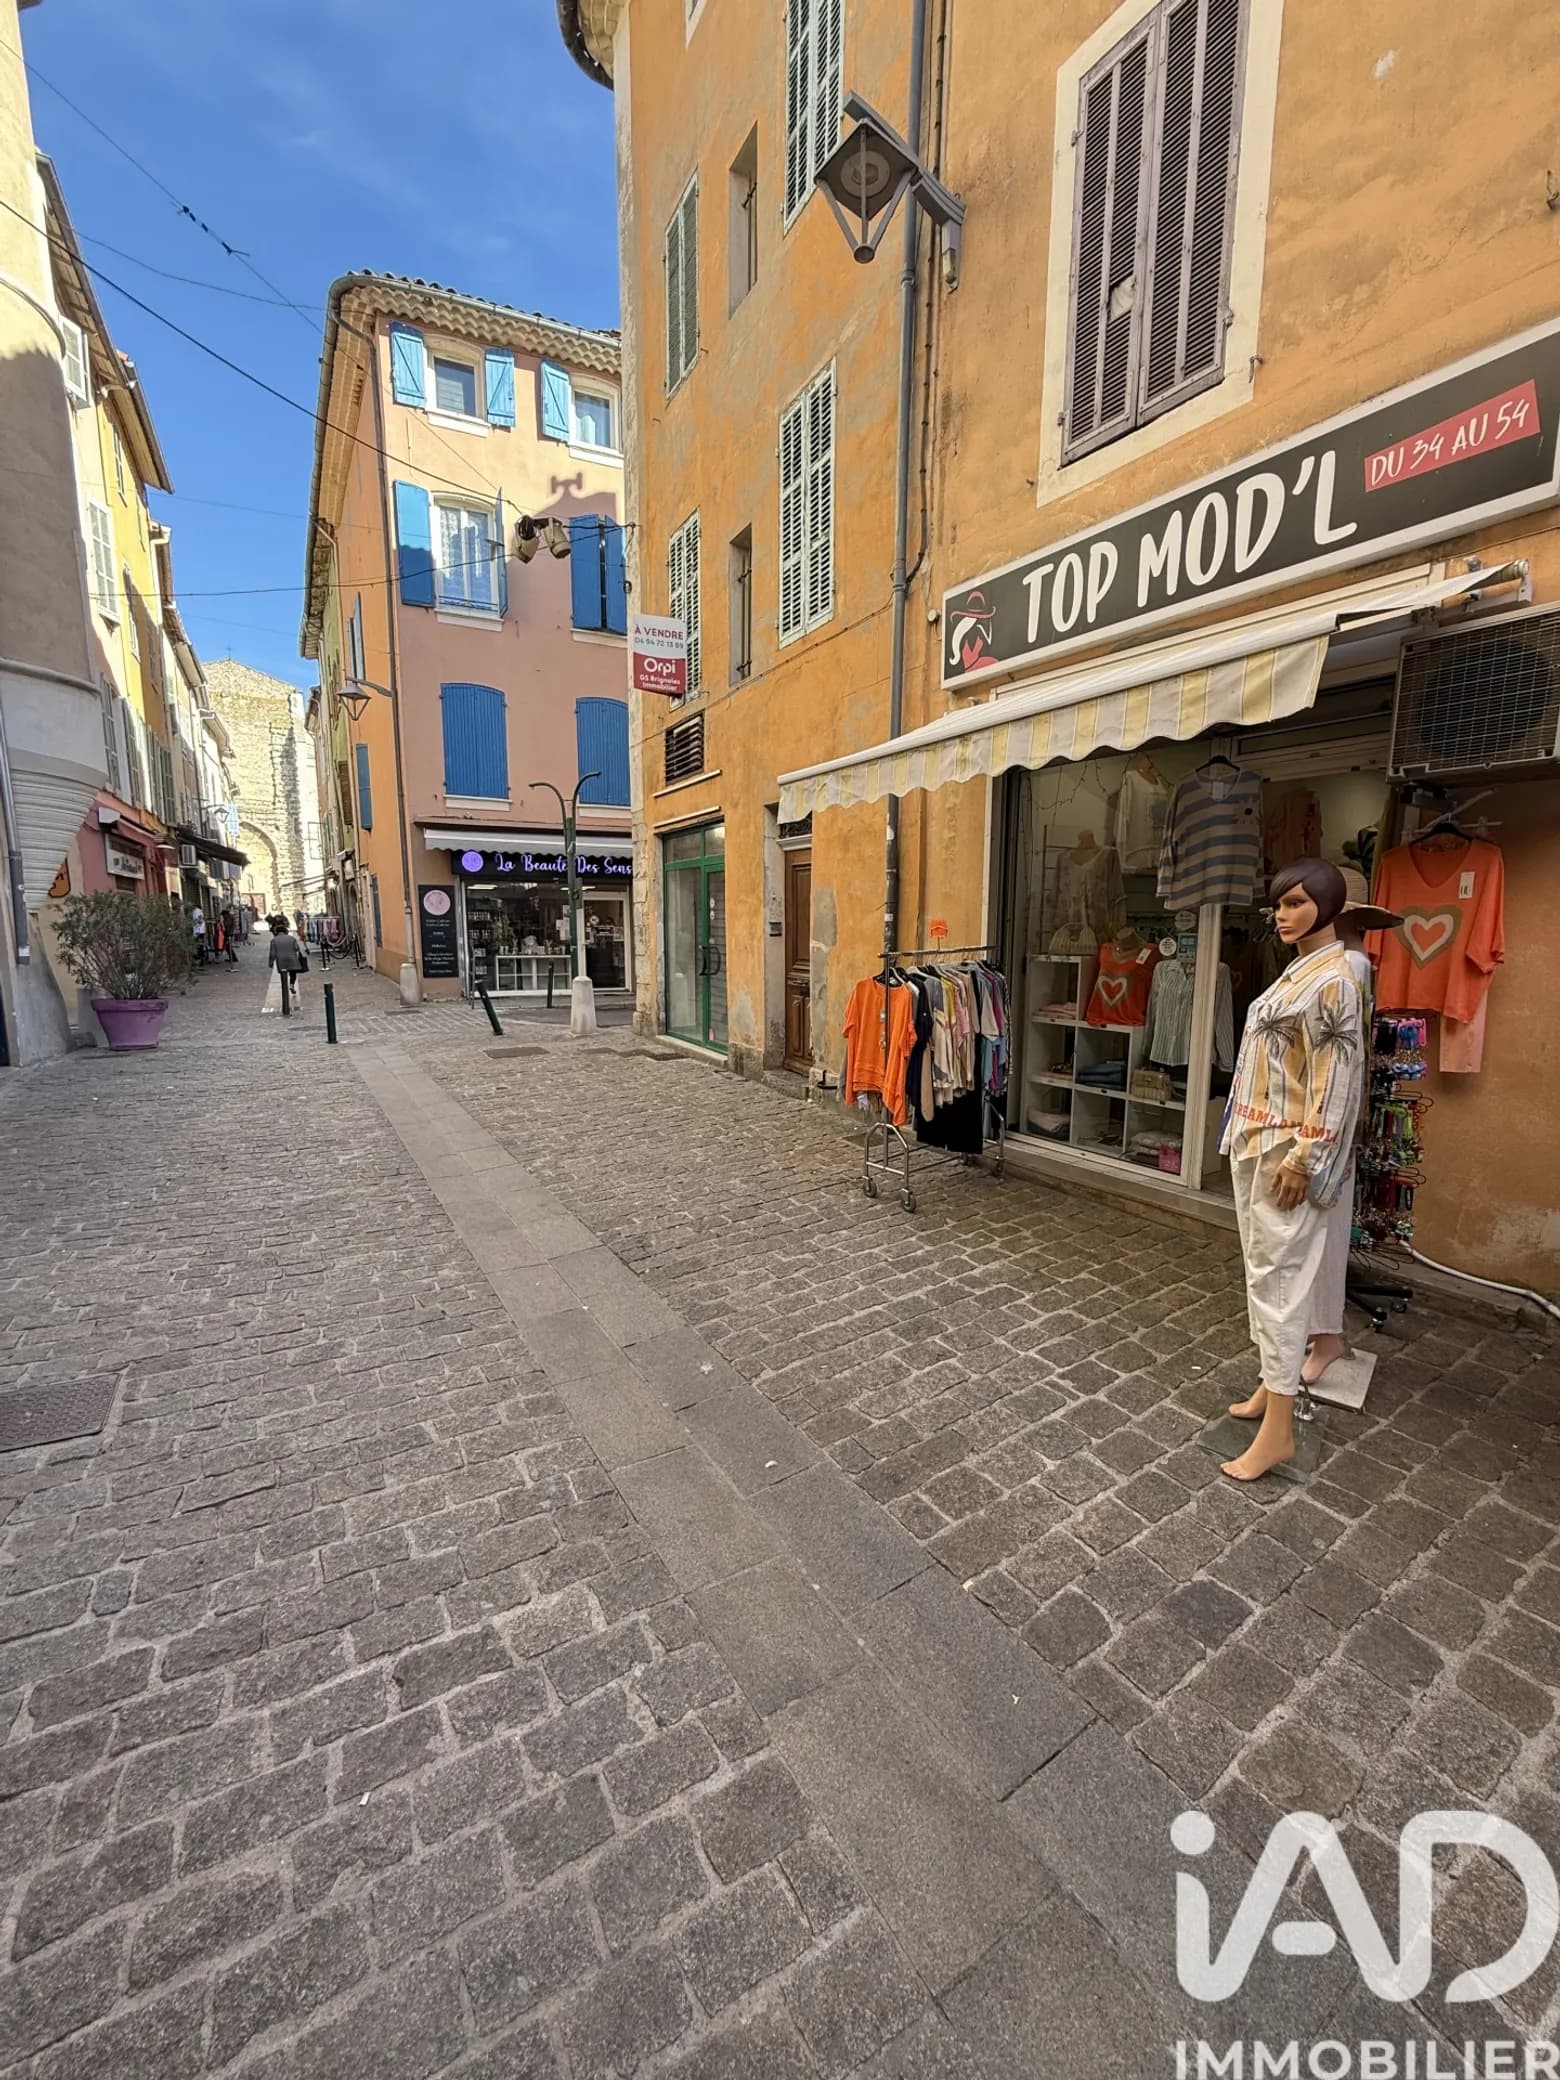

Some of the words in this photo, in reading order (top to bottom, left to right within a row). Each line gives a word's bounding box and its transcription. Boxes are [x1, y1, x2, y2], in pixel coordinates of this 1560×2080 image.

[1371, 446, 1406, 489] DU
[1408, 432, 1445, 472] 34
[1451, 414, 1491, 457] AU
[1494, 398, 1531, 441] 54
[1022, 541, 1119, 644] TOP
[1136, 450, 1358, 608] MOD'L
[643, 627, 684, 640] VENDRE
[644, 658, 675, 676] Orpi
[495, 854, 516, 872] La
[574, 855, 600, 873] Des
[603, 856, 633, 875] Sens
